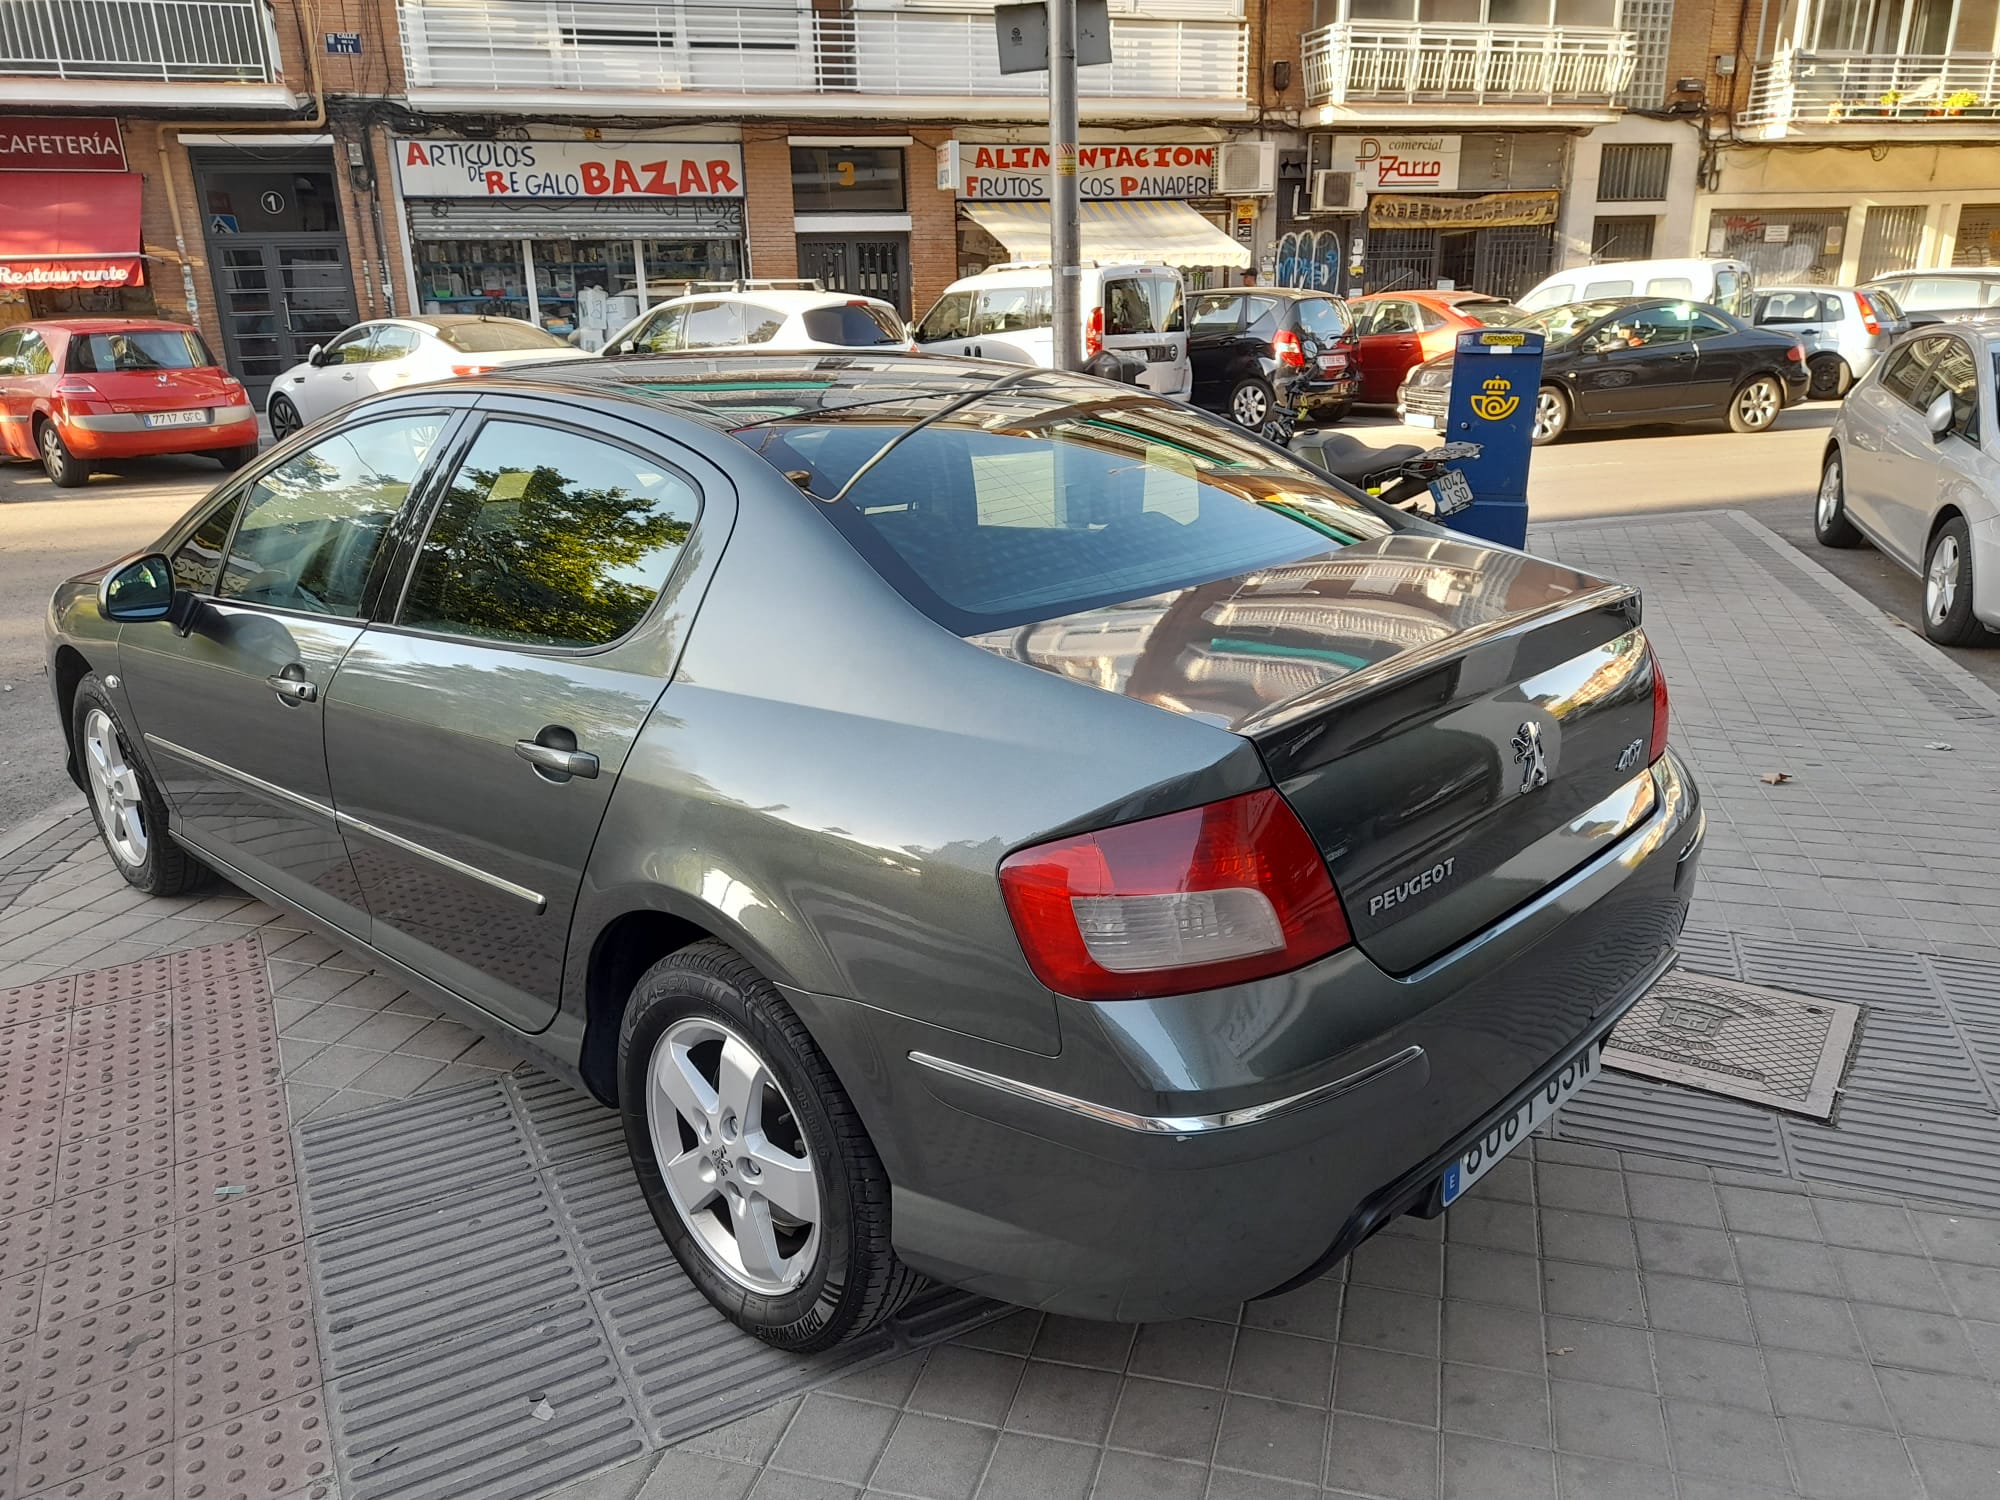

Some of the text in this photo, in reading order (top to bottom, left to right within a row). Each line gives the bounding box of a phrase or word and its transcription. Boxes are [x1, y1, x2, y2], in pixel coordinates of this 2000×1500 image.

[0, 132, 119, 155] CAFETERÍA
[1388, 138, 1443, 151] comercial
[407, 142, 536, 168] ARTICULOS
[975, 147, 1212, 168] ALIMNTACION
[467, 166, 486, 182] DE
[580, 159, 738, 196] BAZAR
[966, 176, 1044, 198] FRUTOS
[1080, 176, 1115, 197] COS
[1119, 175, 1213, 197] PANADERI
[267, 195, 277, 211] 1
[0, 266, 129, 284] Restaurante
[152, 413, 177, 425] 7717
[1439, 471, 1465, 492] 4042
[1447, 487, 1469, 506] LSD
[1615, 738, 1643, 773] 407
[1368, 857, 1456, 917] PEUGEOT
